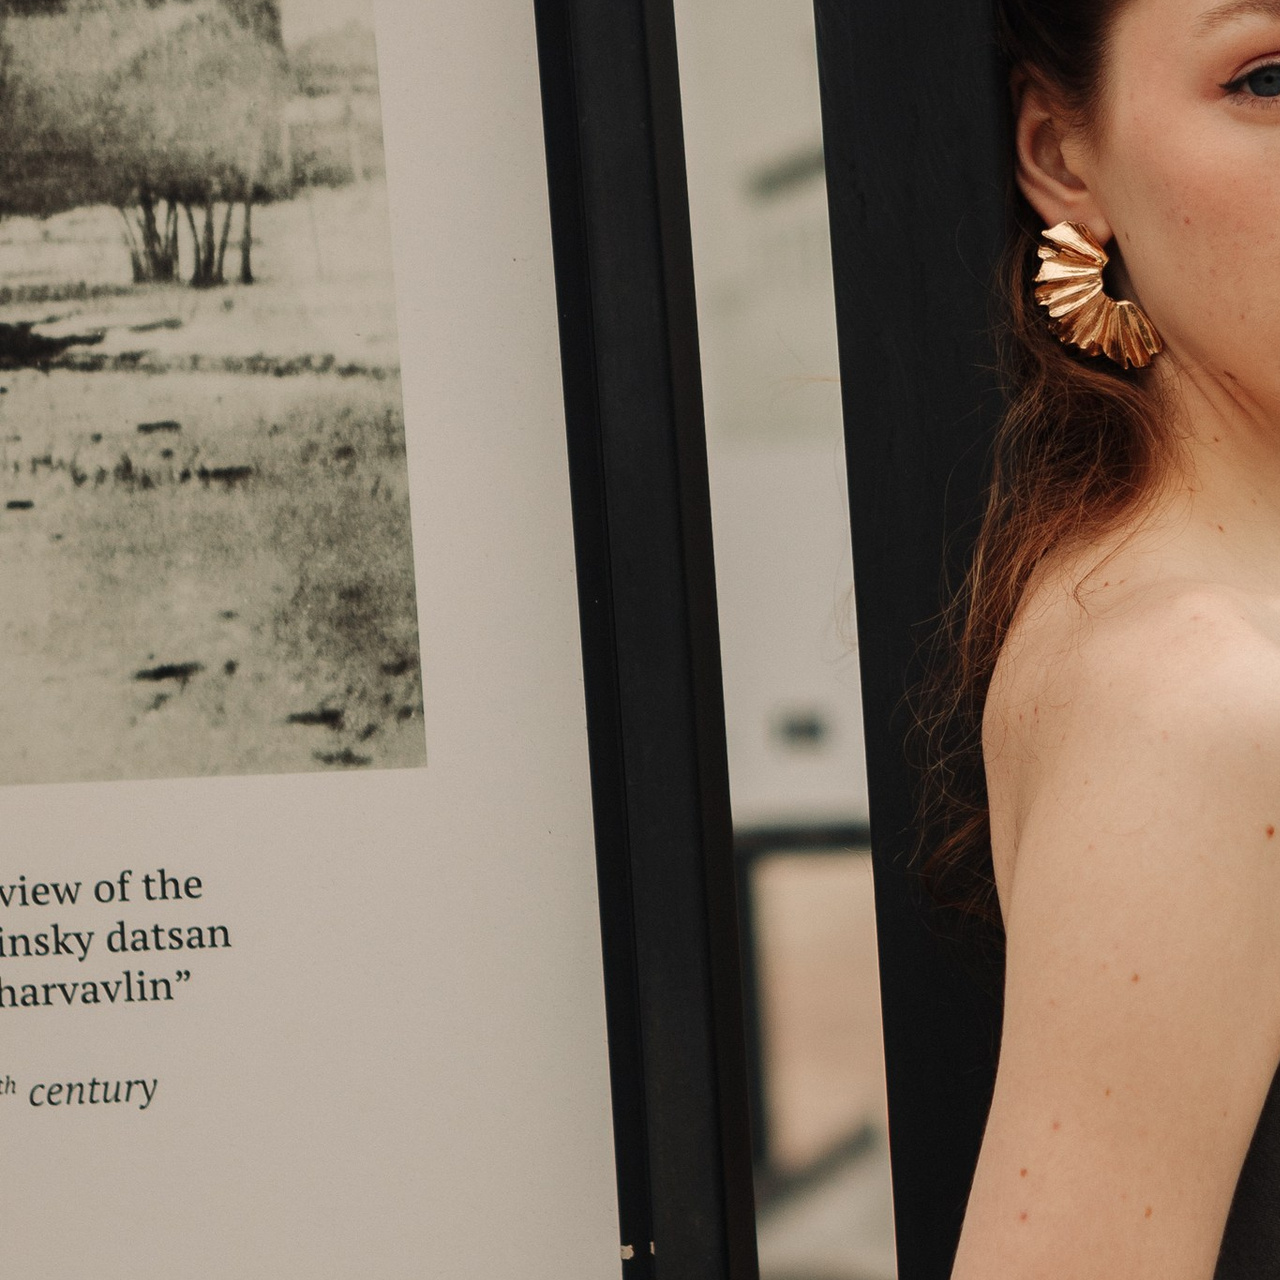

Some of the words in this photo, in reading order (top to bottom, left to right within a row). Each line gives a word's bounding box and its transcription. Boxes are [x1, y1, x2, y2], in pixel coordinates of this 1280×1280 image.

[0, 874, 83, 908] view
[94, 869, 133, 904] of
[142, 868, 203, 902] the
[0, 922, 95, 963] insky
[106, 920, 232, 953] datsan
[29, 1074, 158, 1111] century
